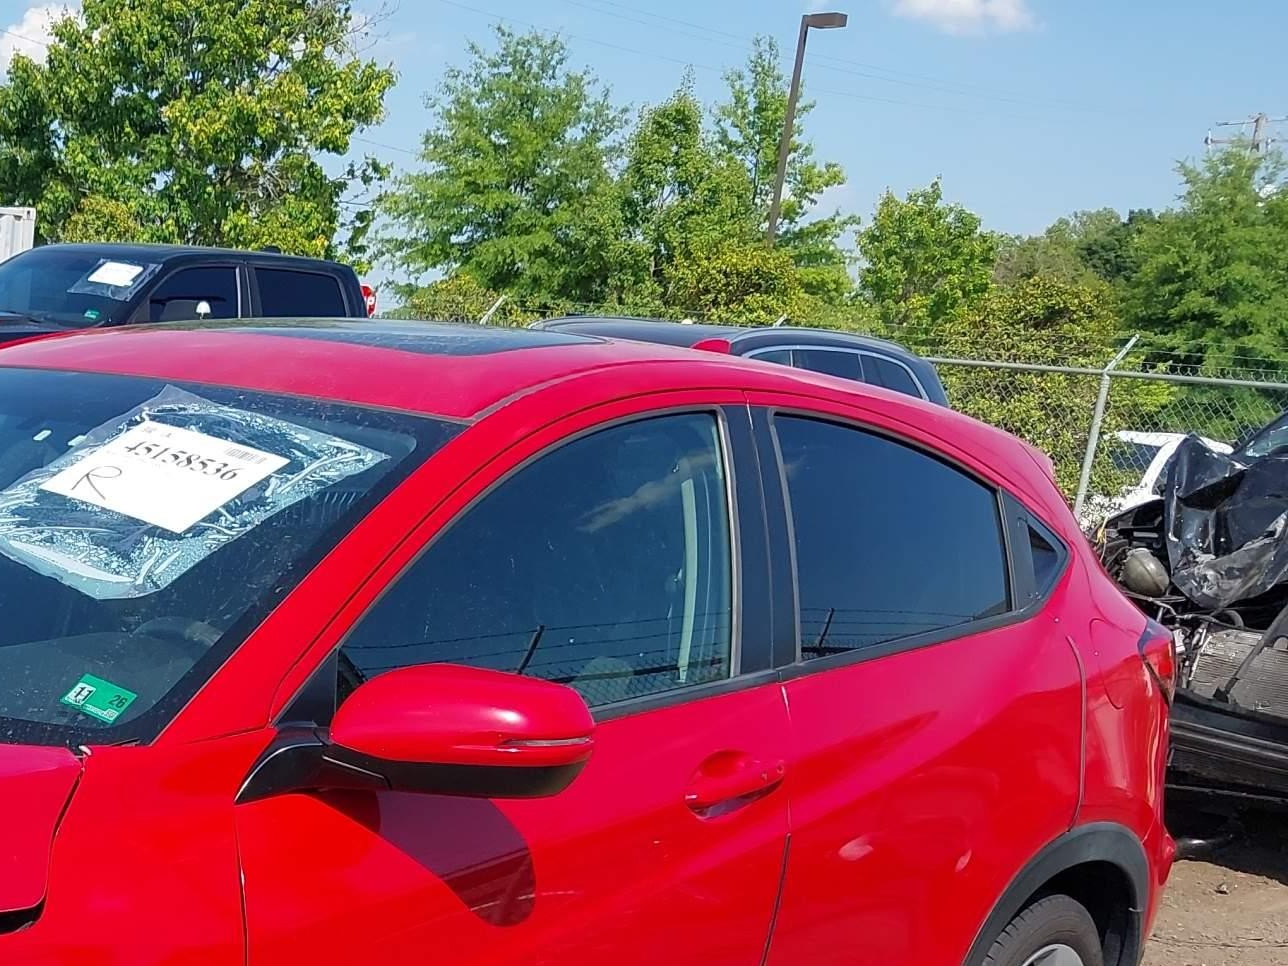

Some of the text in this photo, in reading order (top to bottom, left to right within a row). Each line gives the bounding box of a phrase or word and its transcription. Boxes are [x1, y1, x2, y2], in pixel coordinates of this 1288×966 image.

[125, 440, 241, 481] 45158536
[70, 465, 124, 501] R
[109, 694, 128, 709] 26
